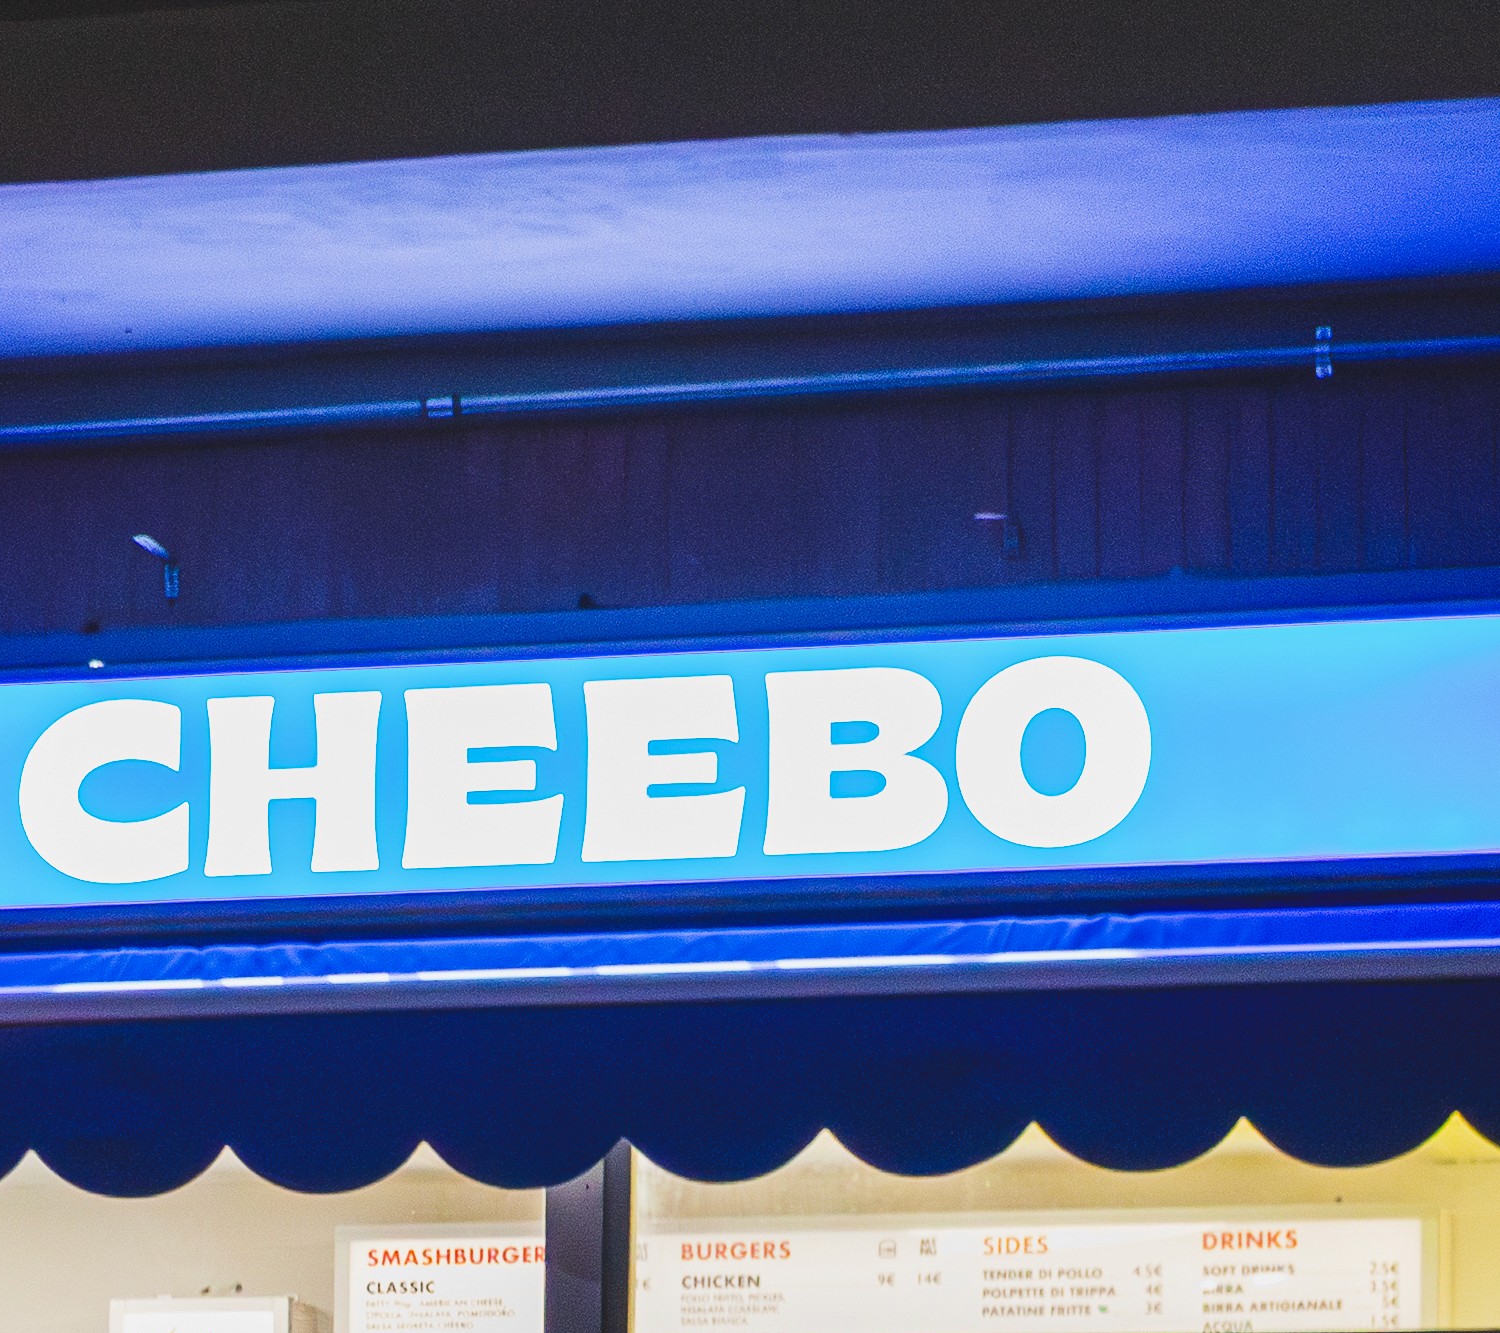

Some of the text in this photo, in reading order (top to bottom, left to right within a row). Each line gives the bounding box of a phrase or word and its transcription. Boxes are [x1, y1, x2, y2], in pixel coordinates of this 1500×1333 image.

[18, 656, 1152, 885] CHEEBO
[982, 1235, 1050, 1256] SIDES
[1201, 1229, 1299, 1250] DRINKS
[366, 1245, 545, 1267] SMASHBURGER
[680, 1240, 792, 1262] BURGERS
[982, 1268, 1033, 1281] TENDER
[1038, 1268, 1053, 1280] DI
[1057, 1266, 1103, 1280] POLLO
[1202, 1264, 1236, 1276] SOFT
[366, 1280, 436, 1295] CLASSIC
[681, 1274, 761, 1290] CHICKEN
[982, 1286, 1046, 1300] POLPETTE
[1050, 1285, 1065, 1298] DI
[1069, 1284, 1117, 1297] TRIPPA
[981, 1304, 1045, 1318] PATATINE
[1049, 1304, 1092, 1317] FRITTE
[1202, 1301, 1244, 1314] BIRRA
[1249, 1298, 1343, 1313] ARTIGIANALE
